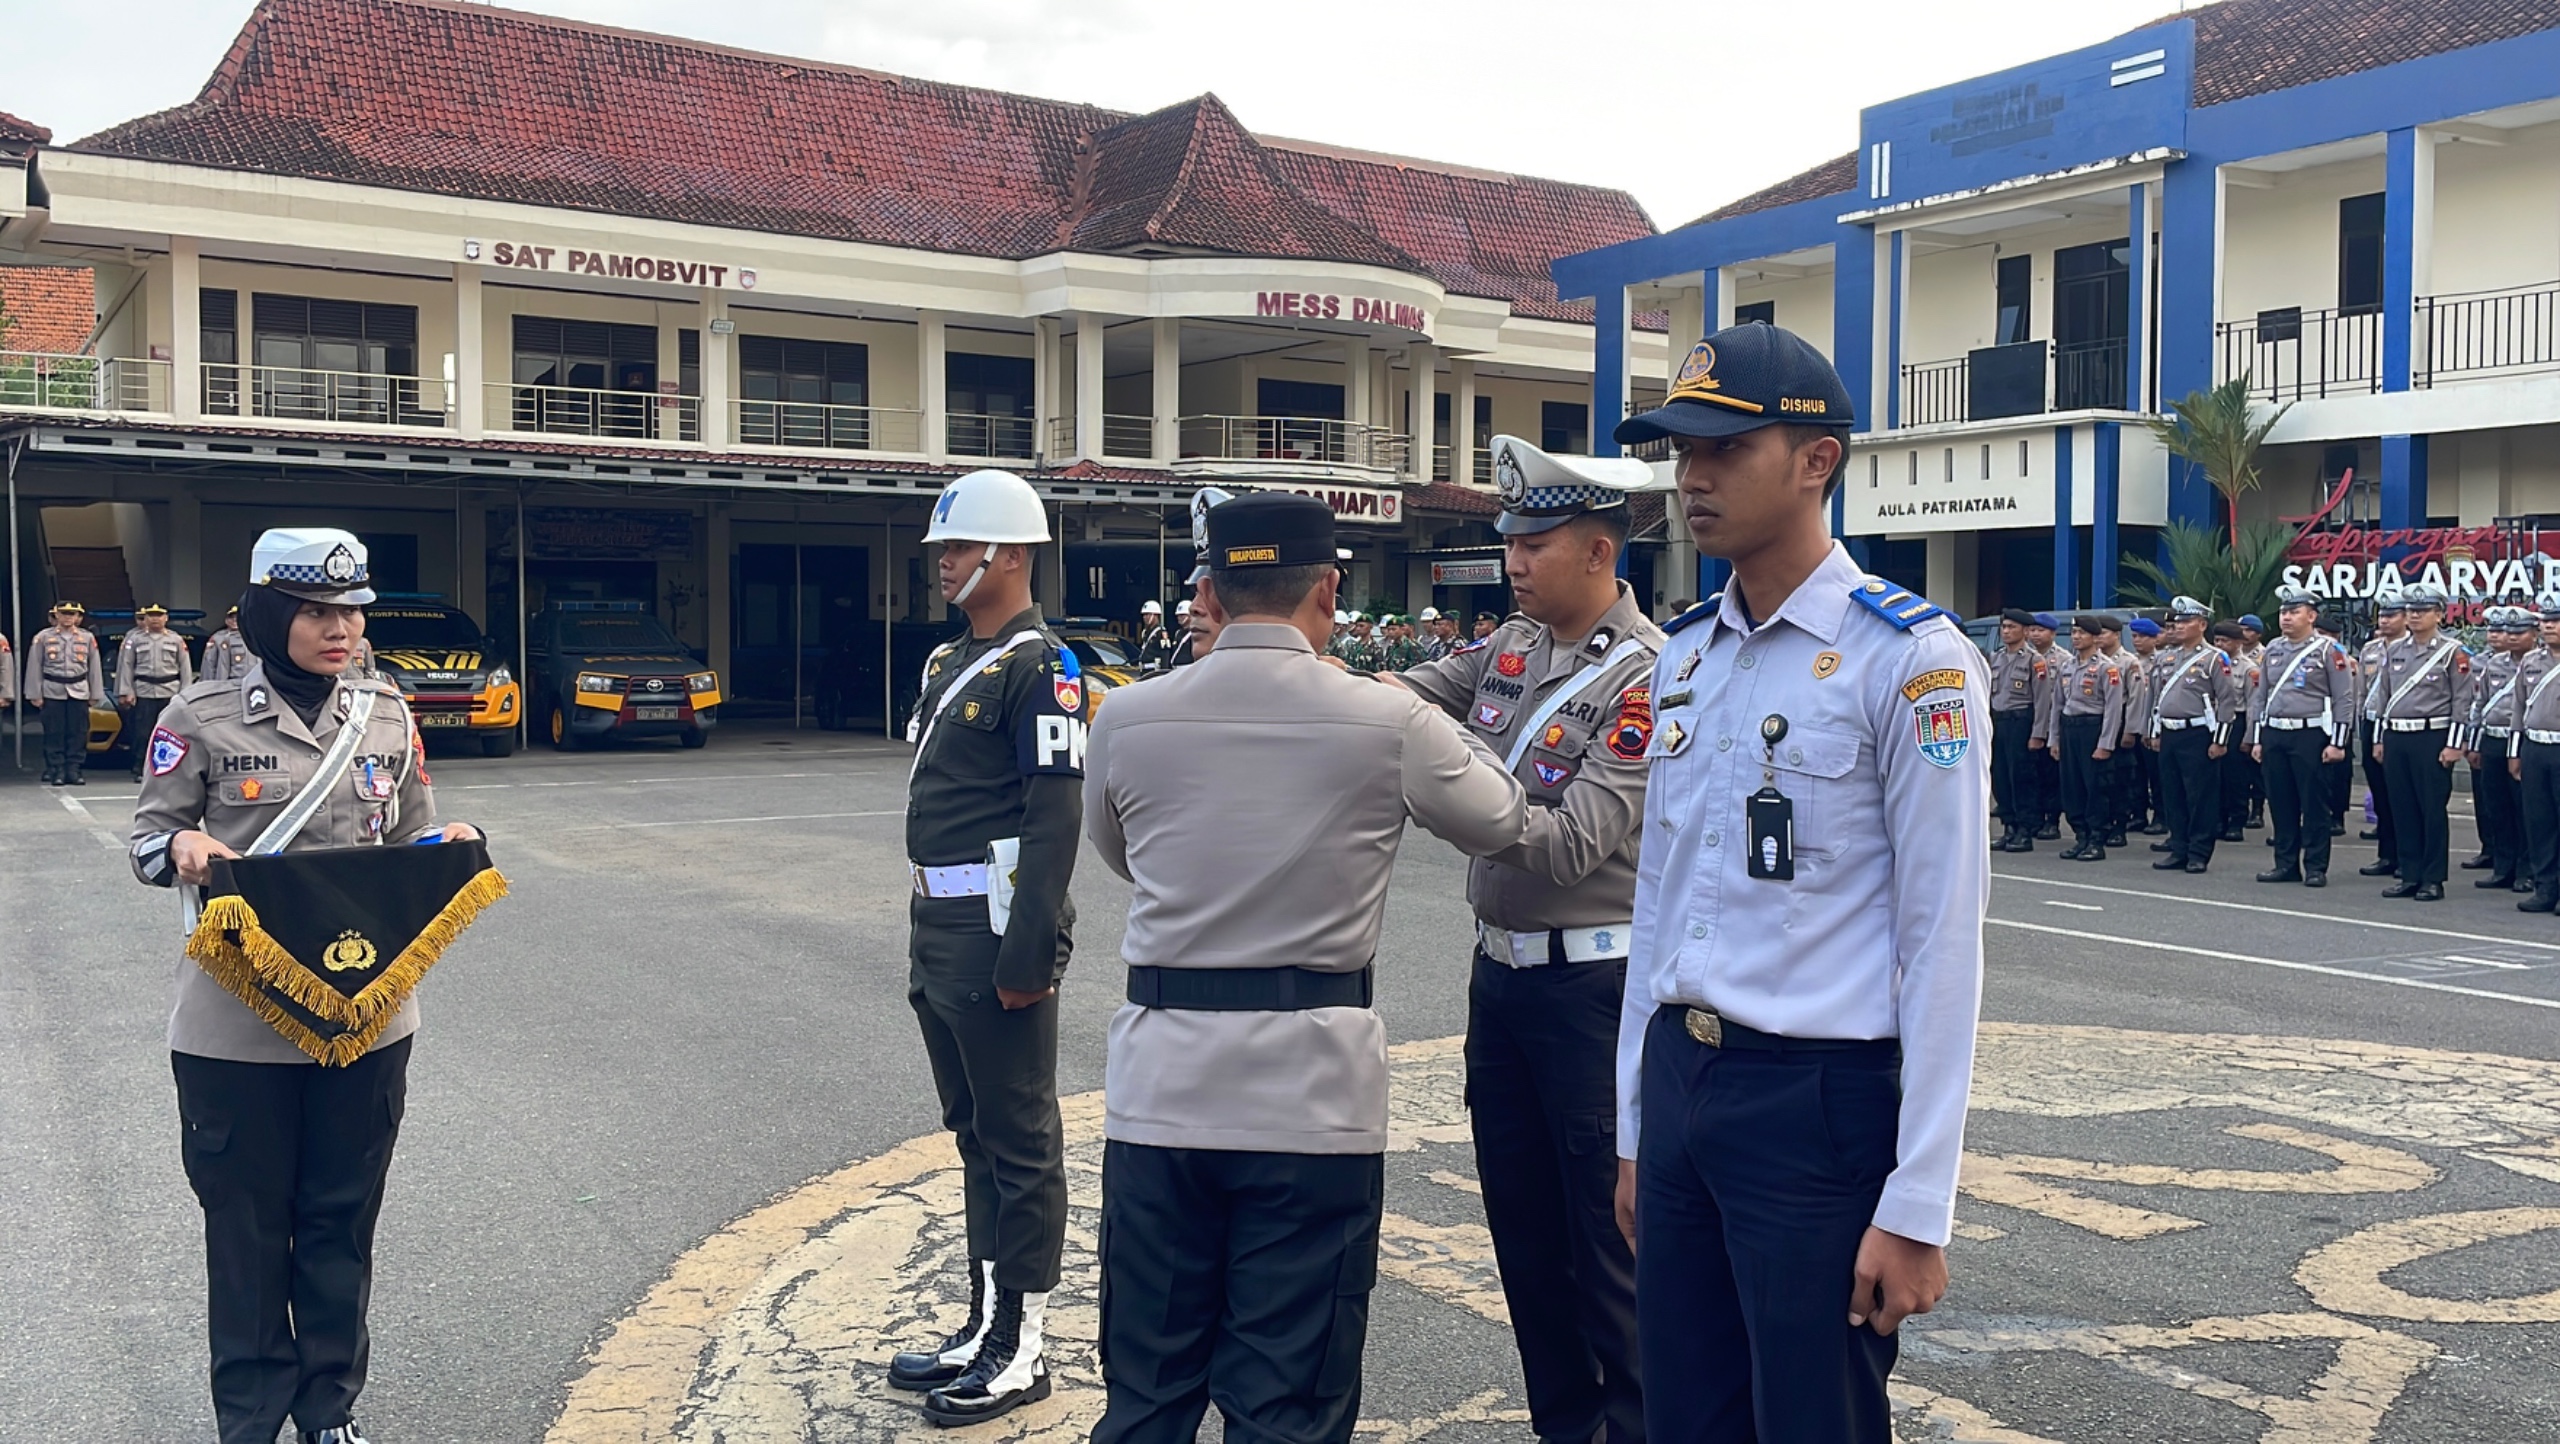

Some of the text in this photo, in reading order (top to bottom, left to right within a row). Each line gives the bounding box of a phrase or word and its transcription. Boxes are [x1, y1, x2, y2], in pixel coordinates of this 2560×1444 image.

[494, 242, 728, 287] SAT PAMOBVIT
[1257, 292, 1425, 331] MESS DALMAS
[1780, 397, 1826, 413] DISHUB
[1878, 496, 2017, 517] AULA PATRIATAMA
[2278, 467, 2507, 574] Lapangan
[2282, 562, 2405, 598] SARJA
[2419, 560, 2535, 598] ARYA
[427, 671, 459, 679] ISUZU
[1906, 671, 1961, 693] PEMERINTAH
[1481, 676, 1524, 701] ANWAR
[1558, 699, 1599, 723] OLRI
[223, 754, 278, 773] HENI
